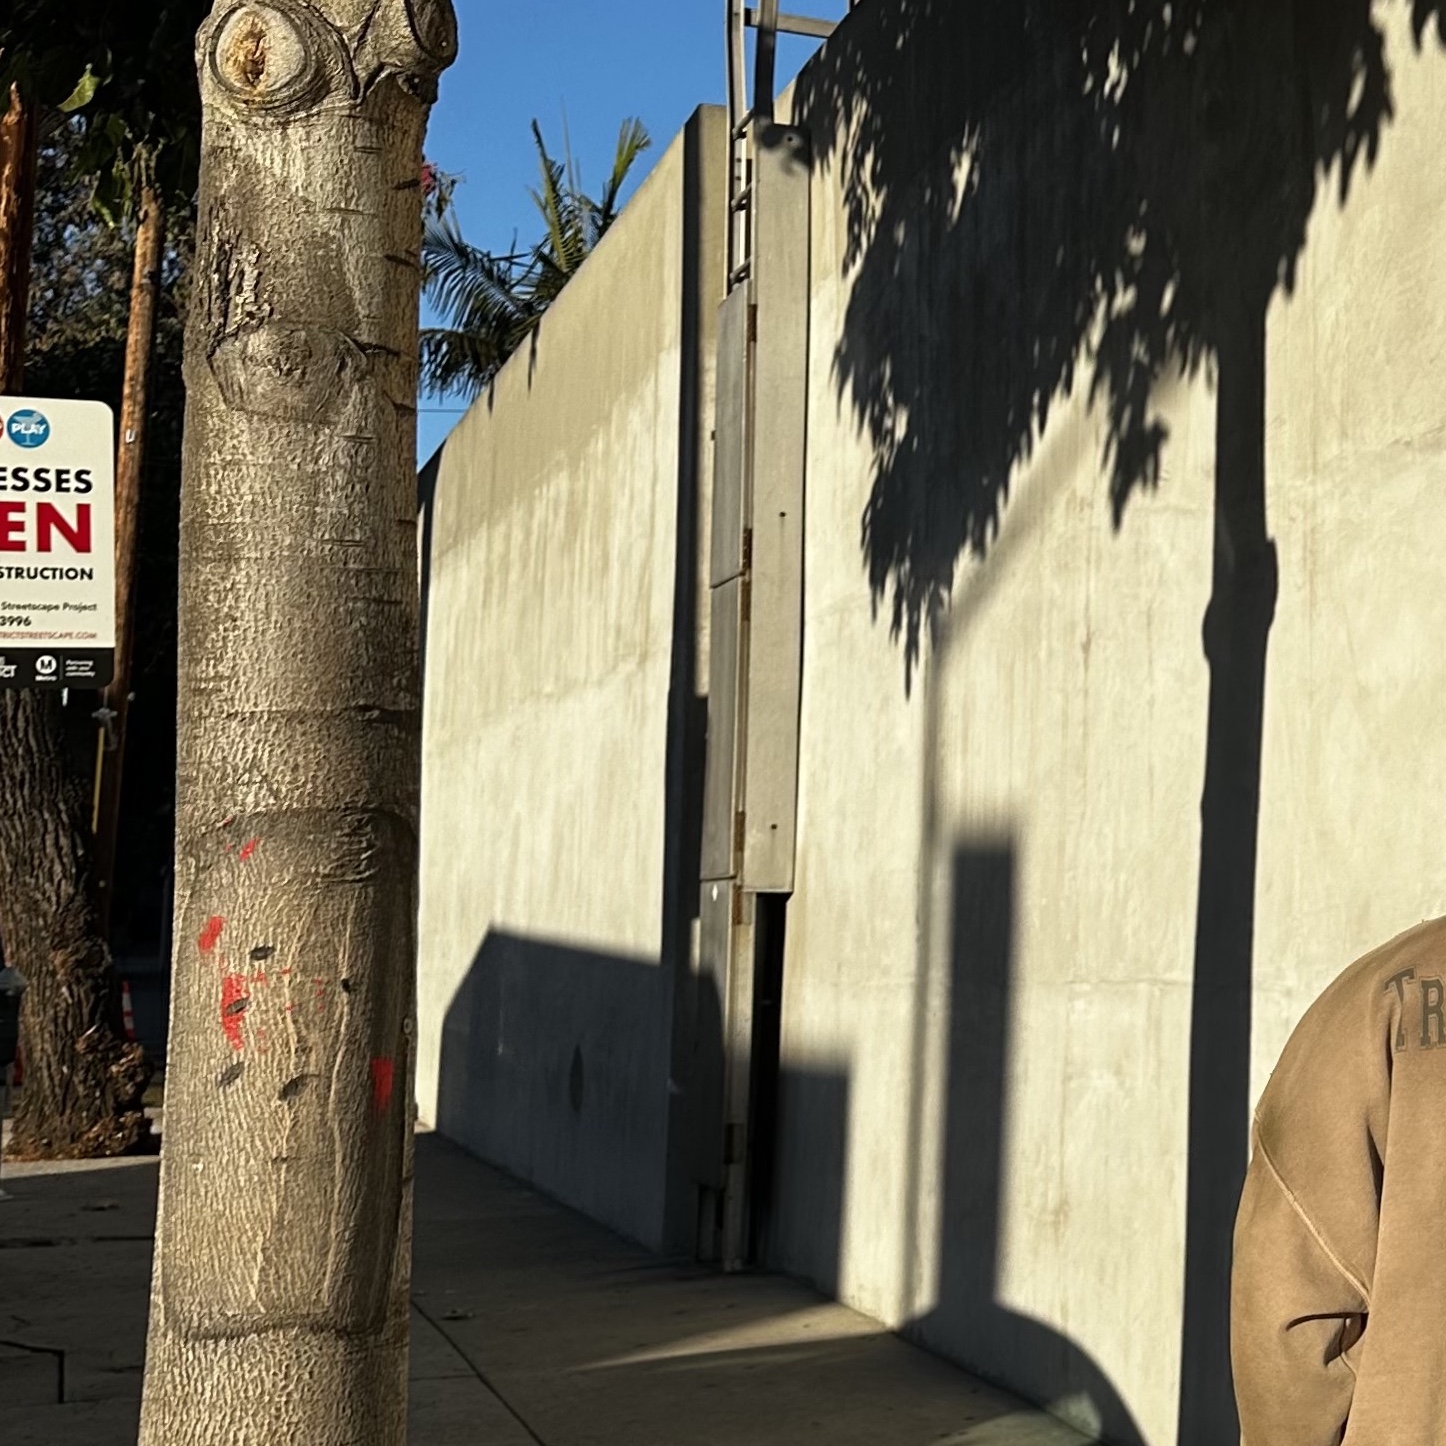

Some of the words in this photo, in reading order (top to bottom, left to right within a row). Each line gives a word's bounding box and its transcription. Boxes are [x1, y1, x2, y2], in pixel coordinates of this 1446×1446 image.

[11, 422, 47, 435] PLAY
[0, 500, 91, 553] EN
[1, 601, 60, 612] Streetscape
[62, 602, 97, 613] Project
